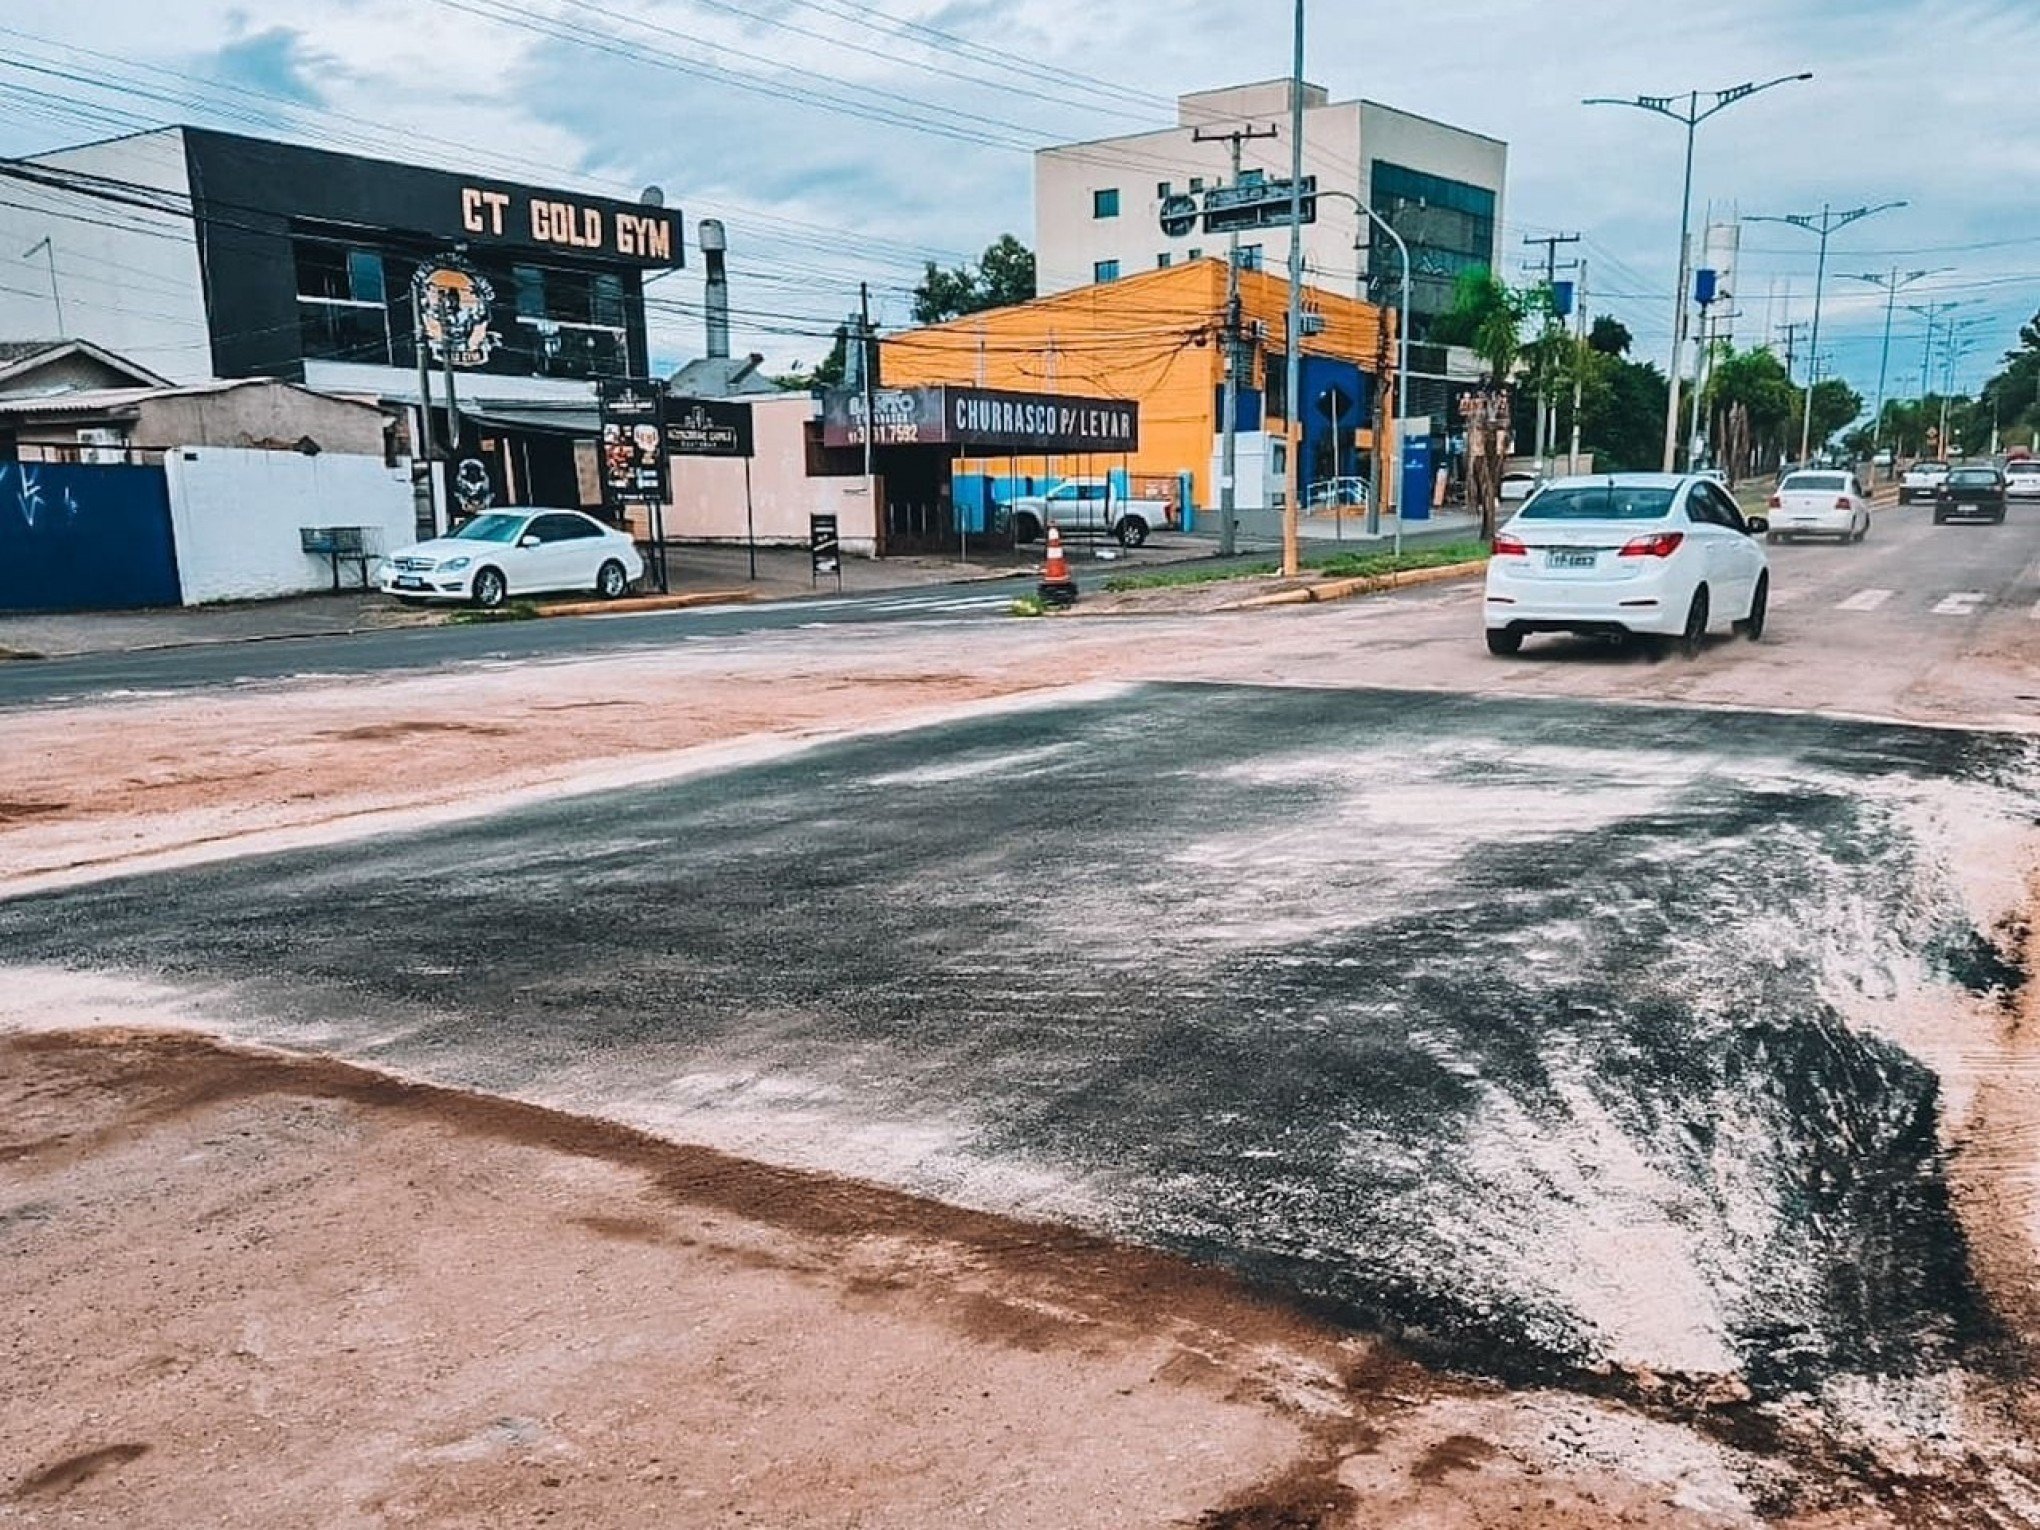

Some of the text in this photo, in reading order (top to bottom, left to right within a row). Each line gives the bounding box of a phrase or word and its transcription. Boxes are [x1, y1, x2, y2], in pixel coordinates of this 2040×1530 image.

[461, 187, 671, 260] CT GOLD GYM
[955, 397, 1057, 436] CHURRASCO
